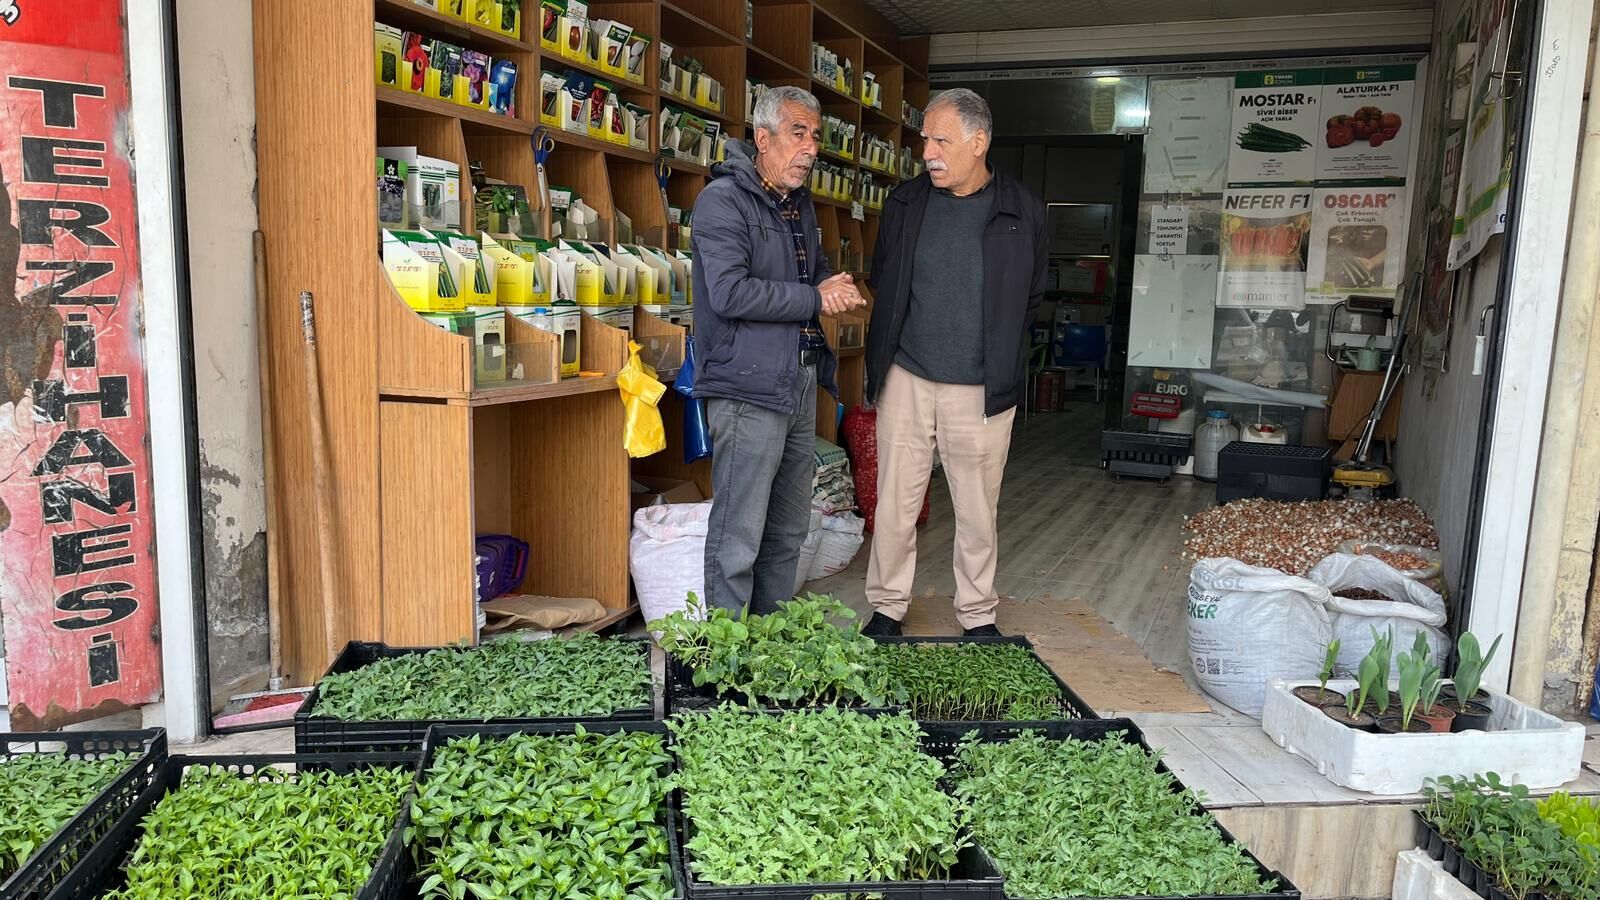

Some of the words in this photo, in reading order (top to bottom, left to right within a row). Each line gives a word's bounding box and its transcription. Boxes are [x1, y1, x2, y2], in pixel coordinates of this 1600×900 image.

[1336, 85, 1387, 94] ALATURKA
[1239, 93, 1304, 107] MOSTAR
[1307, 96, 1317, 104] F1
[1256, 108, 1276, 116] SİVRİ
[1224, 194, 1286, 210] NEFER
[1289, 194, 1310, 208] F1
[1324, 193, 1388, 208] OSCAR
[1155, 382, 1188, 396] EURO
